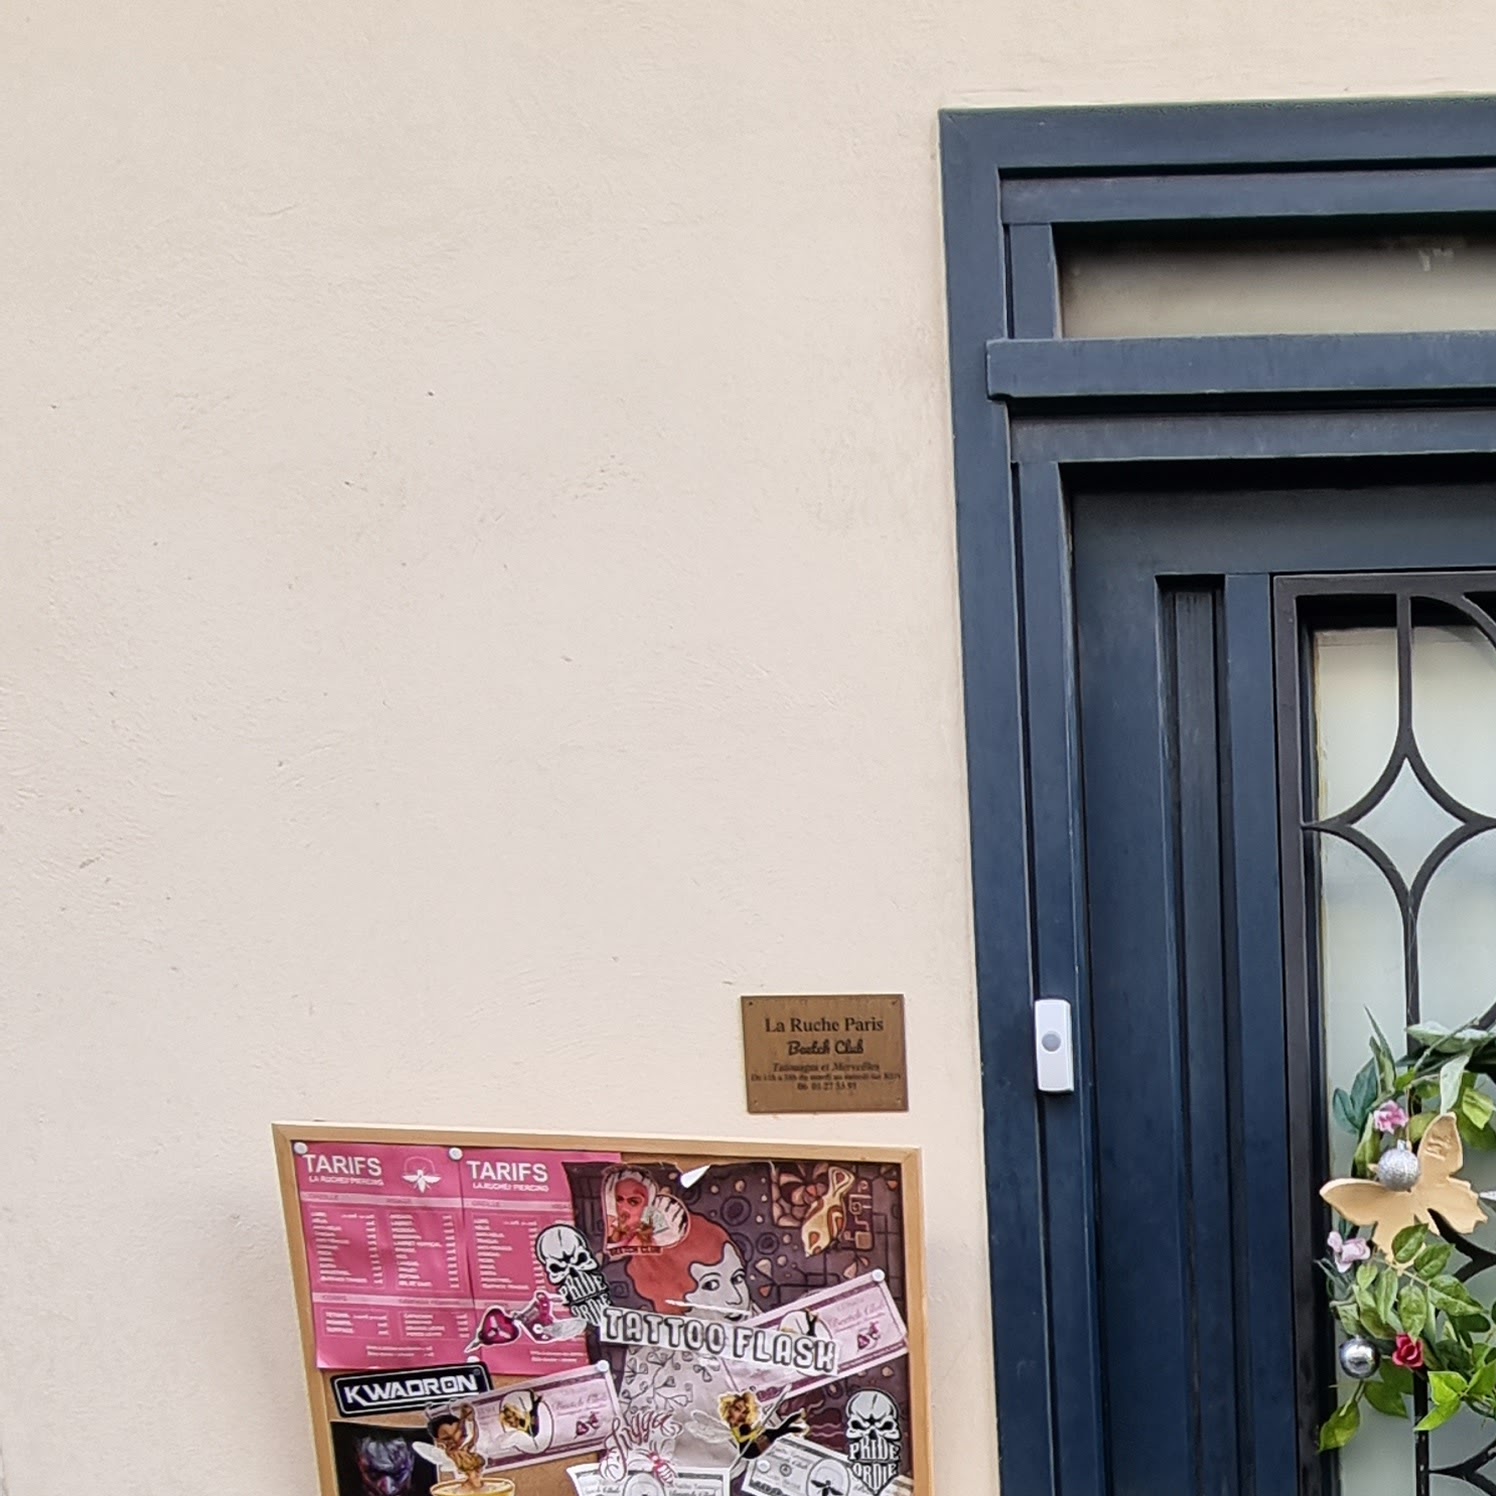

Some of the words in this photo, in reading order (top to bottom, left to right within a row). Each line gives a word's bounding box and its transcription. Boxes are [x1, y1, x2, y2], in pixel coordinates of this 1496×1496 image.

[764, 1018, 785, 1032] La
[790, 1017, 840, 1032] Ruche
[844, 1017, 884, 1032] Paris
[835, 1039, 864, 1055] Club
[302, 1154, 382, 1176] TARIFS
[466, 1160, 548, 1182] TARIFS
[559, 1271, 608, 1304] PRIDE
[603, 1308, 726, 1355] TATTOO
[343, 1373, 479, 1406] KWADRON
[849, 1435, 899, 1461] PRIDE
